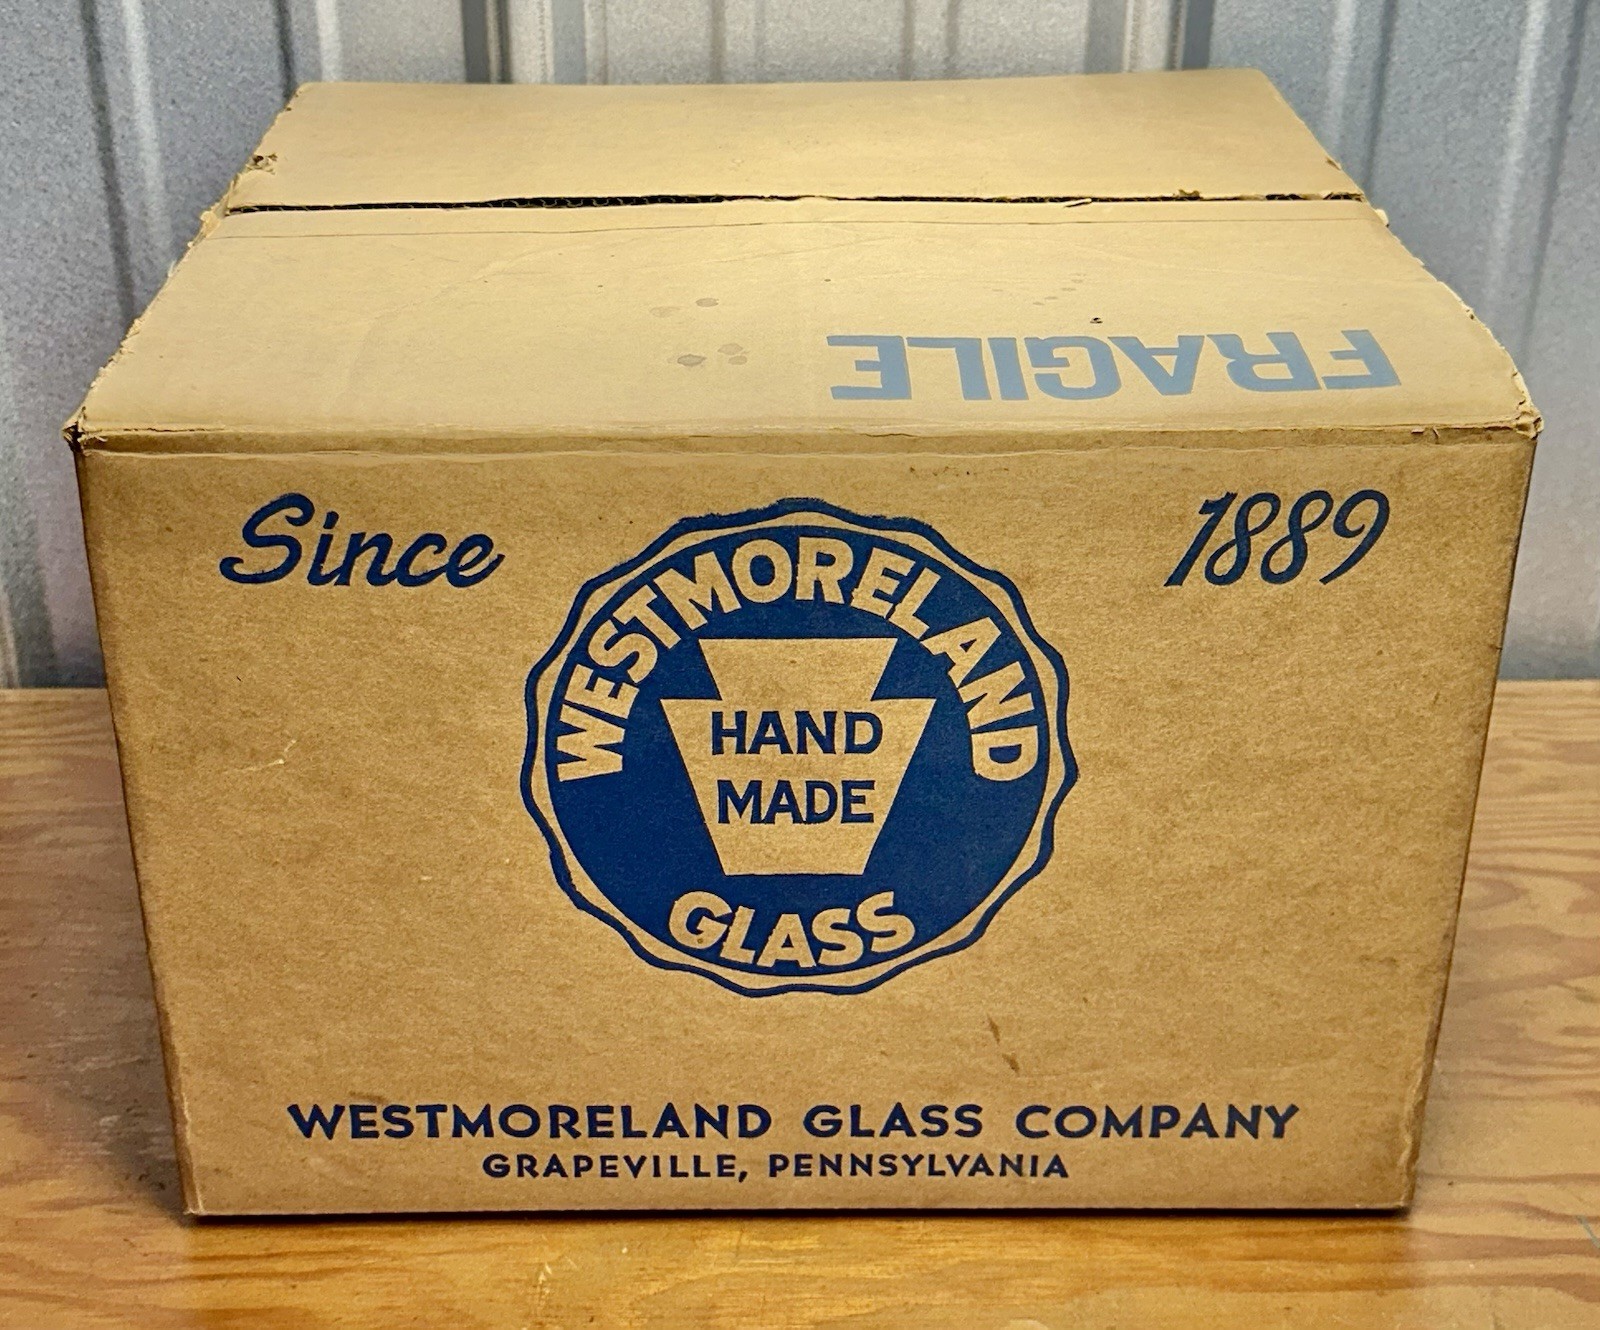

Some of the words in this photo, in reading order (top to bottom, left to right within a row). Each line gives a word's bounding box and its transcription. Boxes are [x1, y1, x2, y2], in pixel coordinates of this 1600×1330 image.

[827, 329, 1402, 401] FRAGILE
[219, 493, 504, 588] Since
[1164, 488, 1391, 588] 1889
[557, 536, 1038, 782] WESTMORELAND
[711, 710, 883, 755] HAND
[717, 780, 875, 824] MADE
[668, 891, 915, 968] GLASS
[287, 1103, 771, 1139] WESTMORELAND
[803, 1103, 983, 1138] GLASS
[1015, 1102, 1299, 1139] COMPANY
[482, 1153, 748, 1182] GRAPEVILLE,
[769, 1152, 1069, 1179] PENNSYLVANIA
